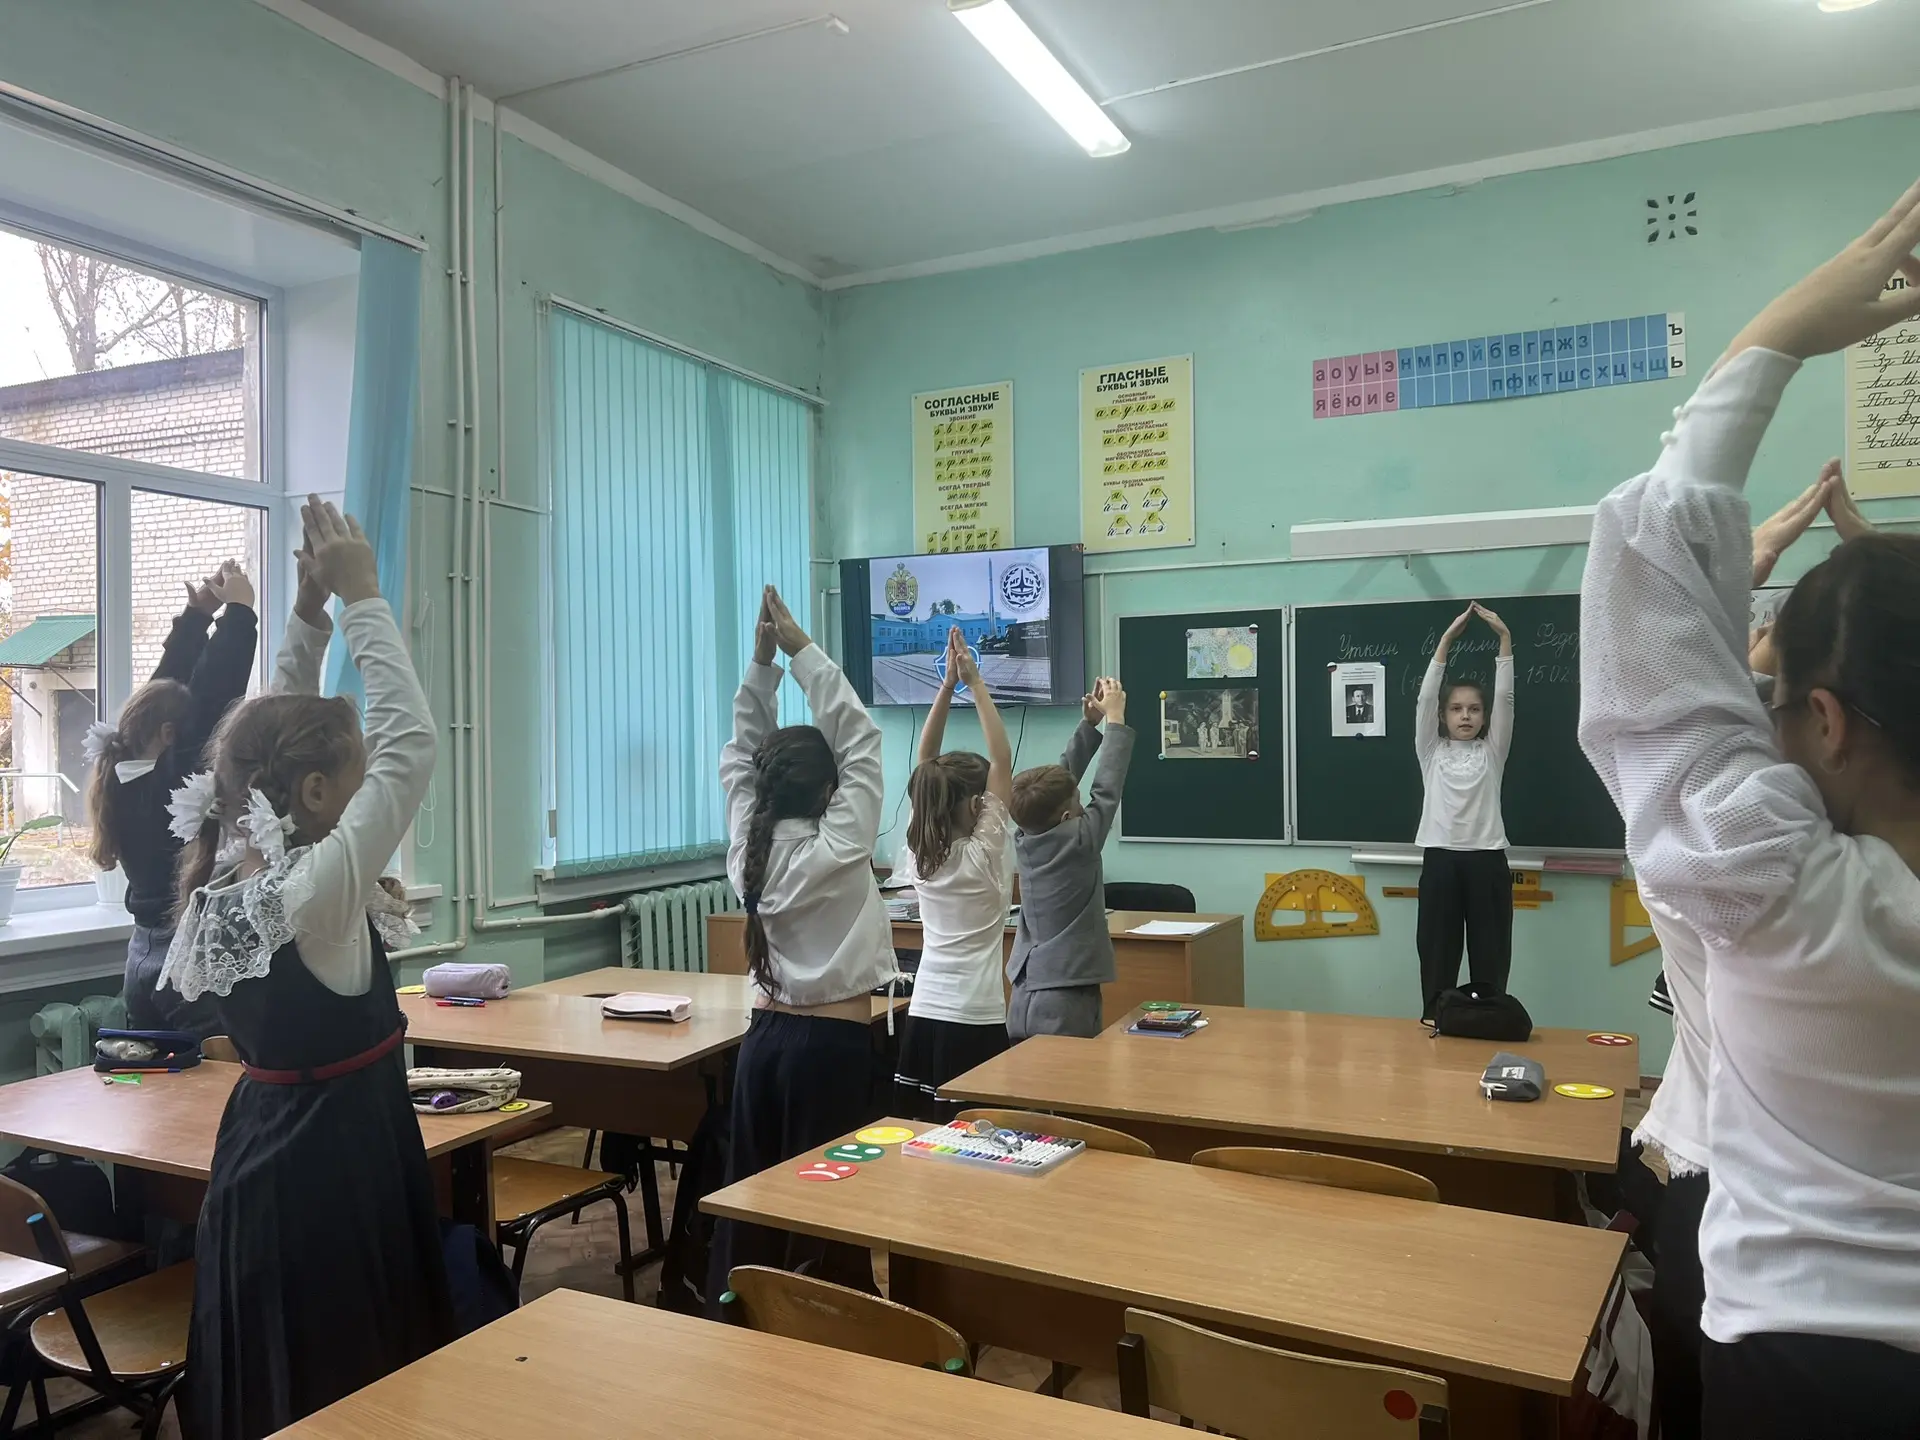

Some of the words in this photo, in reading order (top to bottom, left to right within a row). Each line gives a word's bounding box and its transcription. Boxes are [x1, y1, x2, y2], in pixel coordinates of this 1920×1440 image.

[1100, 366, 1166, 384] ГЛАСНЫЕ
[1097, 382, 1128, 393] БУКВЫ
[1140, 377, 1169, 387] ЗВУКИ
[924, 391, 1000, 410] СОГЛАСНЫЕ
[930, 408, 958, 418] БУКВЫ
[968, 404, 994, 413] ЗВУКИ
[1338, 634, 1398, 660] Уткин
